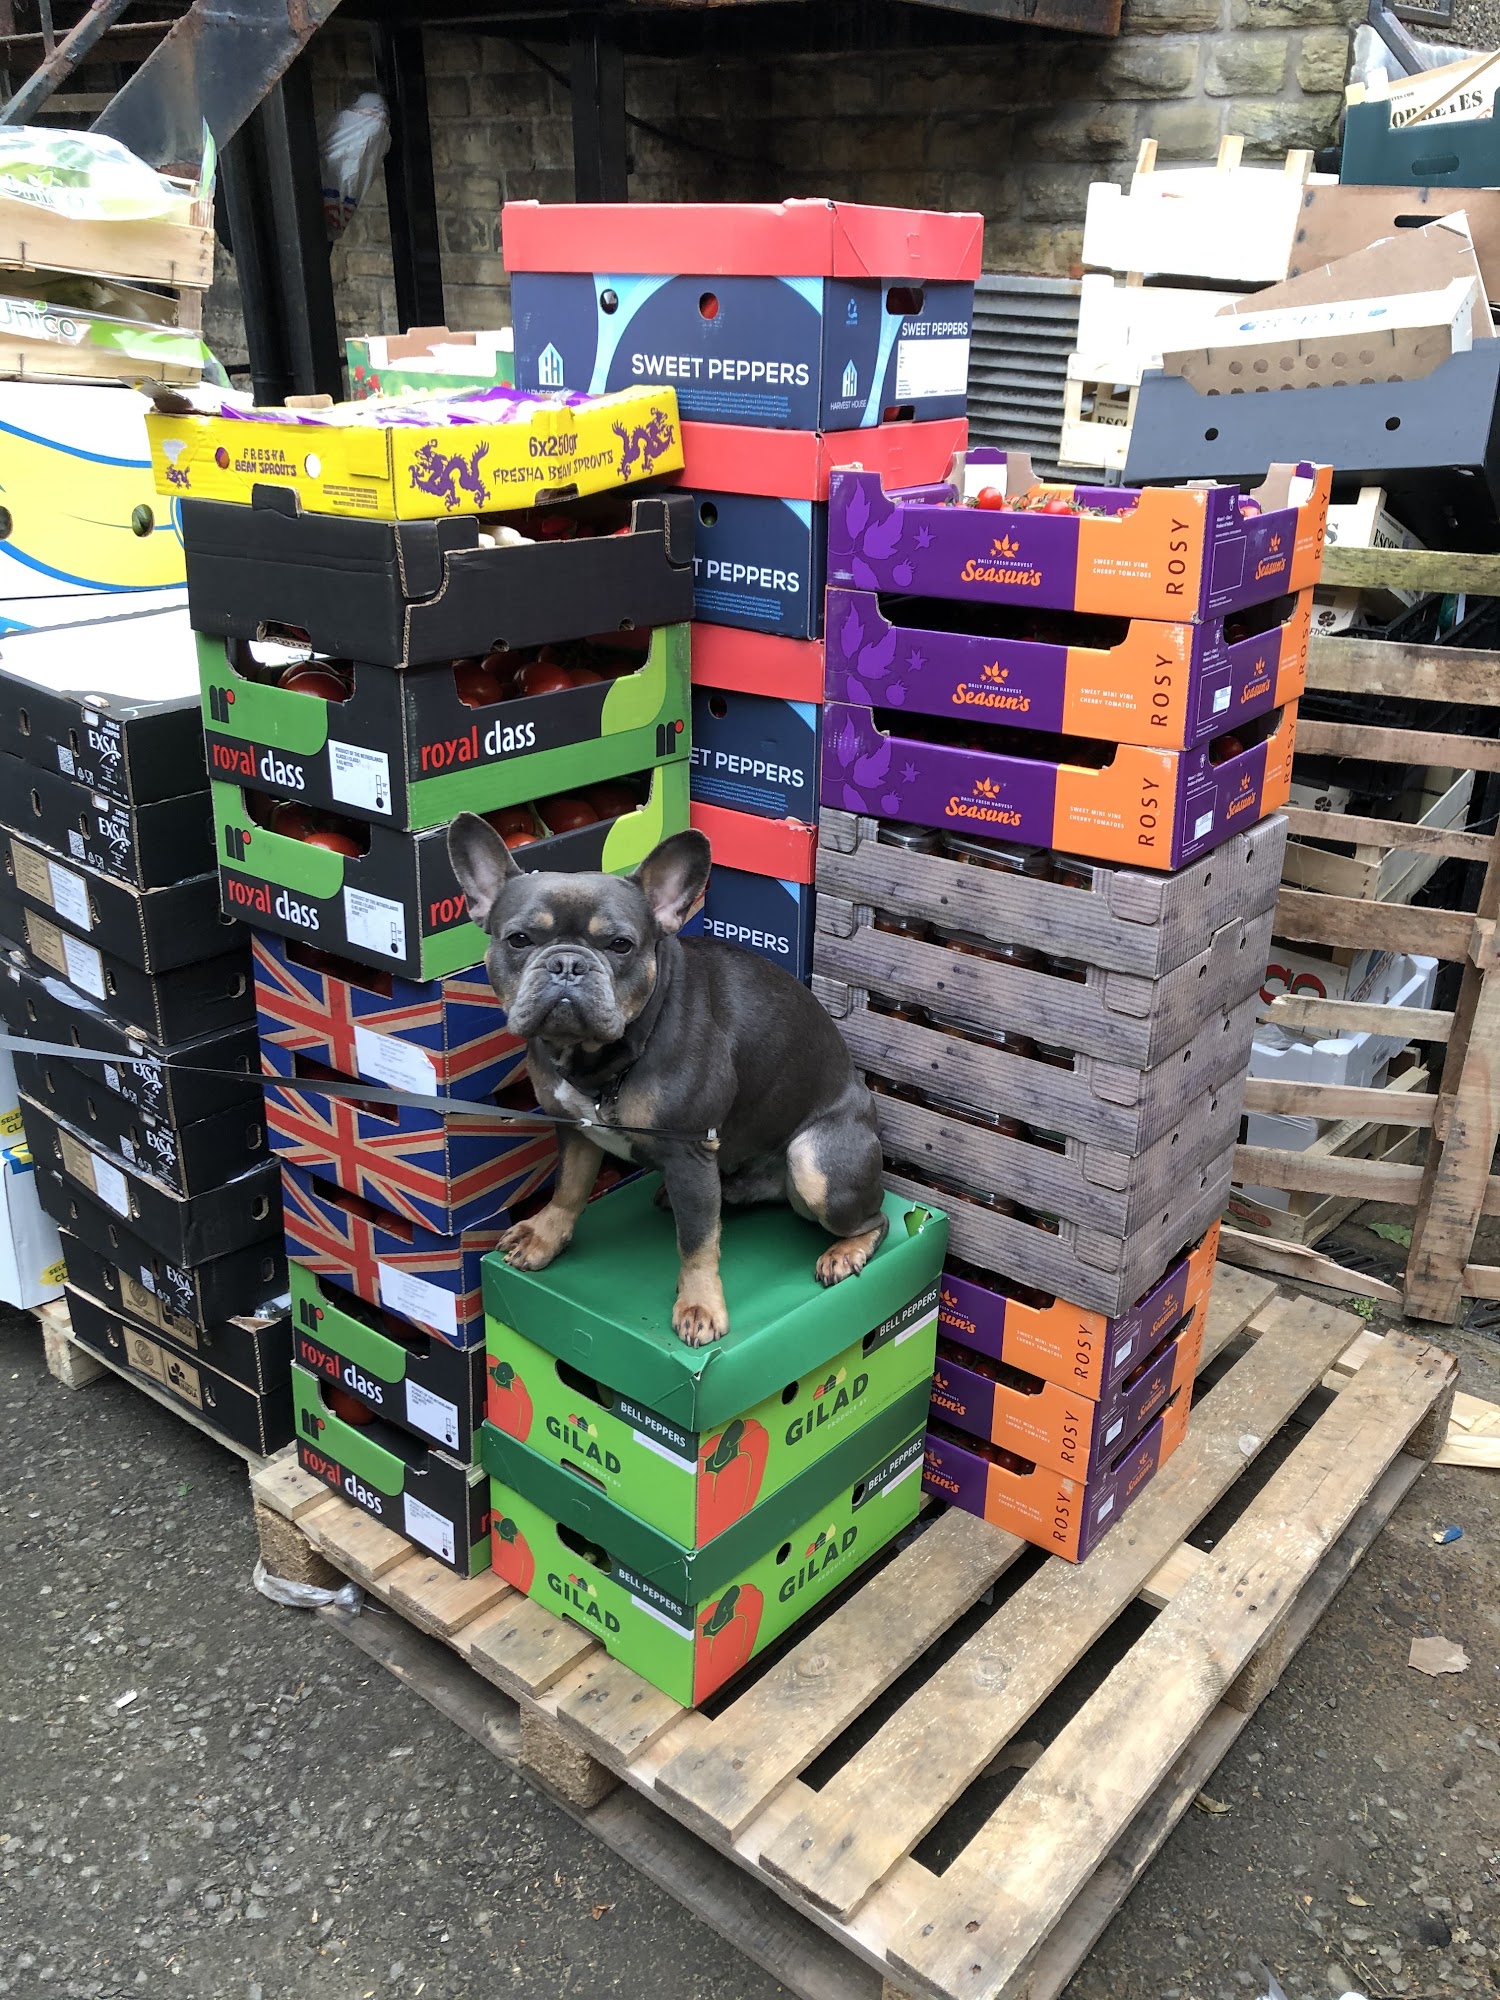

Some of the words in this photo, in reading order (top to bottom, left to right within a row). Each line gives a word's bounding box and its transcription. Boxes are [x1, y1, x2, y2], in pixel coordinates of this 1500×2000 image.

[902, 323, 931, 336] SWEET
[931, 322, 968, 336] PEPPERS
[631, 353, 703, 379] SWEET
[708, 358, 810, 386] PEPPERS
[830, 401, 851, 410] HARVEST
[851, 400, 867, 409] HOUSE
[243, 448, 286, 462] FRESHA
[529, 432, 578, 457] 6x250gr
[235, 461, 257, 474] BEAN
[258, 462, 297, 477] SPROUTS
[493, 466, 544, 485] FRESHA
[548, 465, 572, 482] BEAN
[573, 449, 614, 474] SPROUTS
[1315, 493, 1328, 560] ROSY
[1093, 558, 1114, 566] SWEET
[1116, 559, 1131, 567] MINI
[1166, 518, 1190, 596] ROSY
[1255, 558, 1286, 580] Seasun's
[707, 560, 800, 593] PEPPERS
[961, 559, 1042, 586] Seasun's
[1093, 567, 1117, 575] CHERRY
[1118, 569, 1152, 578] TOMATOES
[1299, 612, 1310, 675] ROSY
[952, 683, 1031, 712] Seasun's
[999, 686, 1022, 694] HARVEST
[1080, 688, 1101, 696] SWEET
[1103, 690, 1117, 698] MINI
[1119, 692, 1134, 700] VINE
[1080, 697, 1102, 705] CHERRY
[1104, 699, 1137, 709] TOMATOES
[1151, 654, 1173, 727] ROSY
[1241, 679, 1270, 704] Seasun's
[88, 729, 117, 754] EXSA
[421, 725, 479, 771] royal
[484, 720, 536, 757] class
[1284, 723, 1295, 784] ROSY
[212, 743, 257, 777] royal
[260, 750, 305, 790] class
[715, 752, 805, 788] PEPPERS
[945, 796, 1021, 826] Seasun's
[976, 798, 991, 806] FRESH
[991, 801, 1013, 810] HARVEST
[1070, 806, 1090, 815] SWEET
[1091, 809, 1106, 817] MINI
[1108, 811, 1122, 820] VINE
[1138, 777, 1159, 846] ROSY
[1226, 792, 1256, 820] Seasun's
[98, 816, 127, 840] EXSA
[1069, 814, 1092, 823] CHERRY
[1093, 818, 1125, 829] TOMATOES
[228, 880, 271, 914] royal
[275, 891, 320, 930] class
[430, 894, 470, 927] roy
[133, 1062, 159, 1082] EXSA
[146, 1130, 172, 1153] EXSA
[166, 1265, 191, 1288] EXSA
[879, 1318, 900, 1337] BELL
[902, 1289, 937, 1321] PEPPERS
[938, 1312, 977, 1334] sun's
[1074, 1324, 1093, 1380] ROSY
[301, 1341, 340, 1379] royal
[344, 1365, 384, 1404] class
[827, 1405, 857, 1430] PRODUCE
[931, 1394, 967, 1416] sun's
[620, 1401, 643, 1422] BELL
[645, 1416, 686, 1448] PEPPERS
[1060, 1411, 1080, 1464] ROSY
[582, 1461, 611, 1481] PRODUCE
[868, 1469, 888, 1491] BELL
[889, 1439, 922, 1474] PEPPERS
[303, 1448, 341, 1486] royal
[344, 1475, 383, 1514] class
[922, 1471, 960, 1494] sun's
[1052, 1492, 1071, 1543] ROSY
[618, 1568, 641, 1589] BELL
[643, 1584, 683, 1616] PEPPERS
